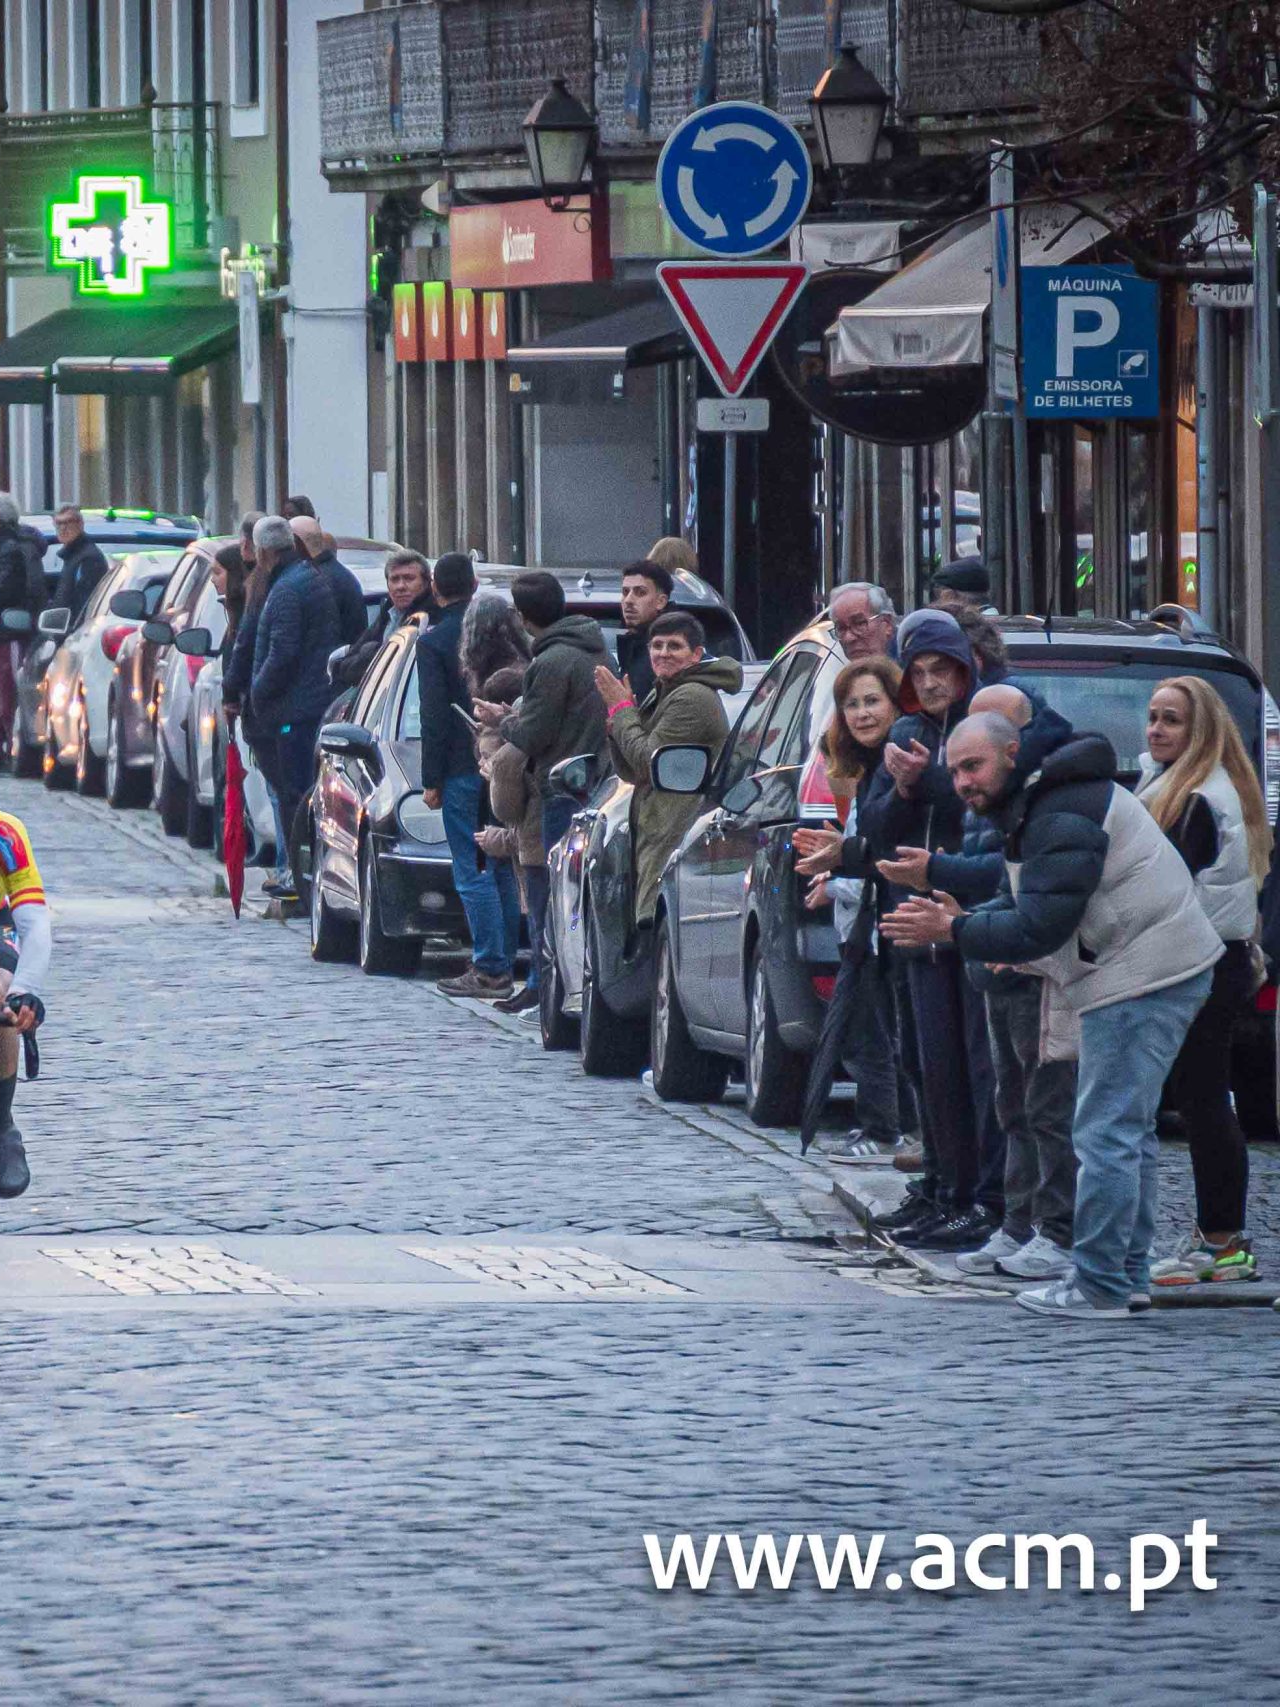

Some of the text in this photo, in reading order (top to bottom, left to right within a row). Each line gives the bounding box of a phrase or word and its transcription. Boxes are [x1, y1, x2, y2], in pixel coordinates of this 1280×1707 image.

[1048, 276, 1122, 292] MÁQUINA
[1056, 295, 1120, 377] P
[1044, 380, 1124, 391] EMISSORA
[1034, 395, 1133, 407] DE BILHETES
